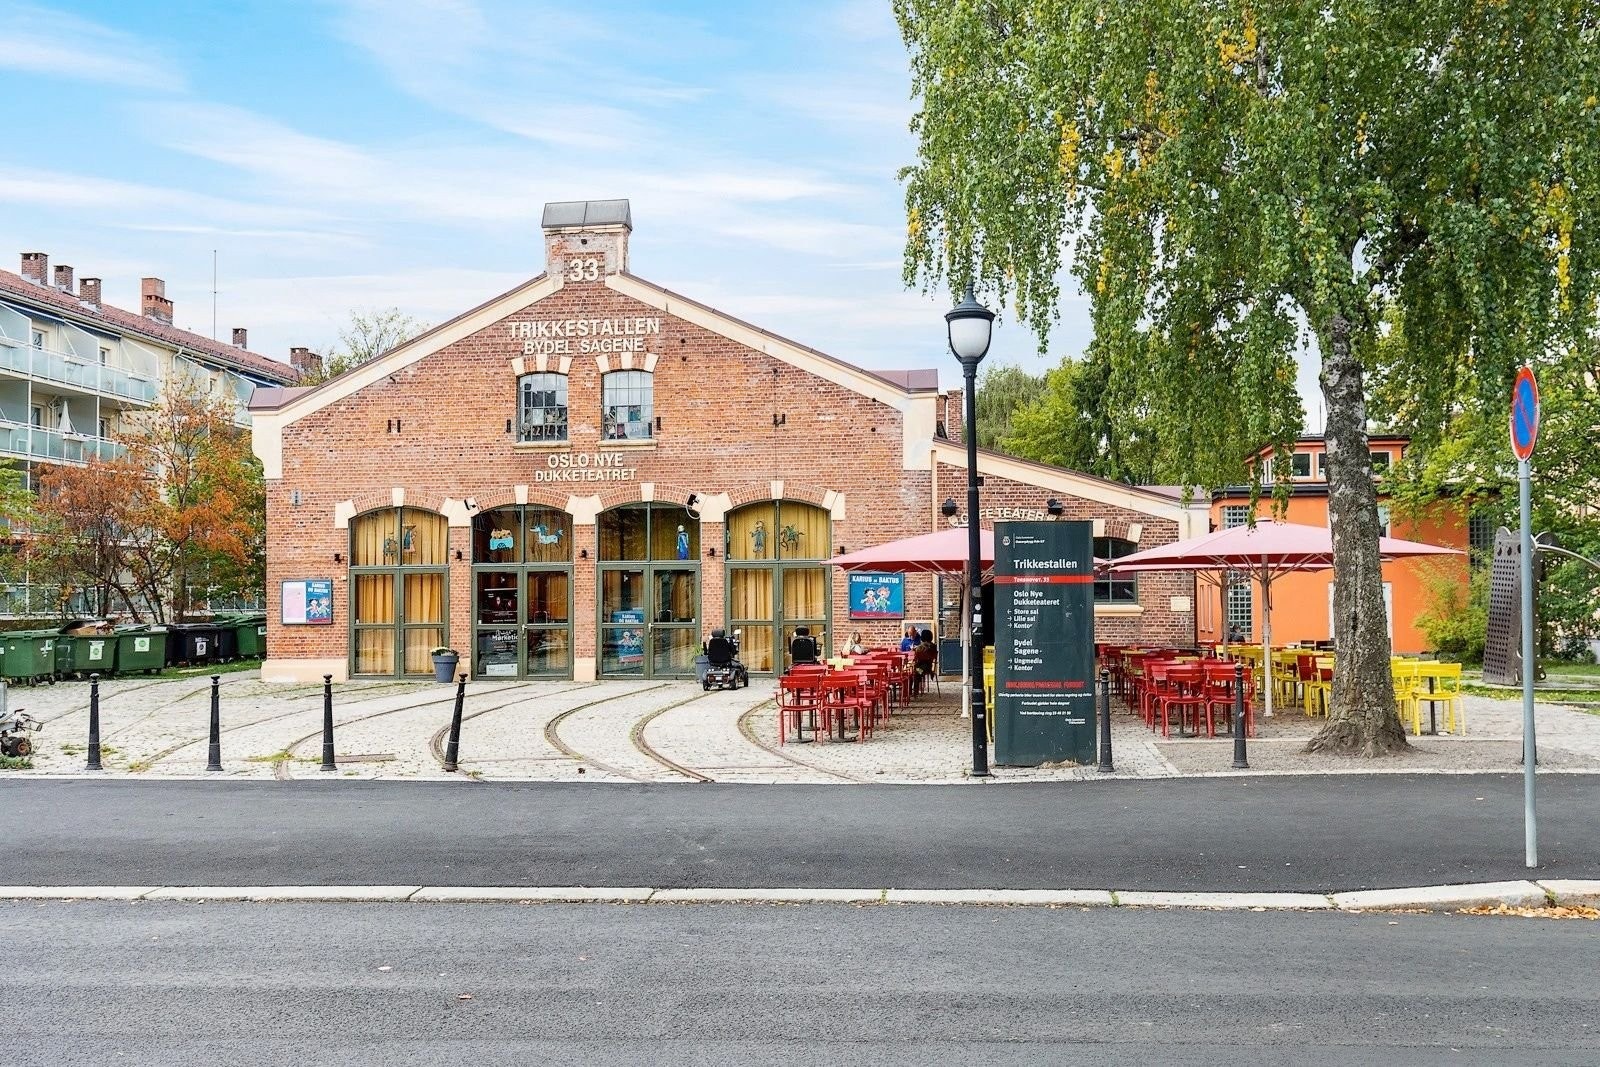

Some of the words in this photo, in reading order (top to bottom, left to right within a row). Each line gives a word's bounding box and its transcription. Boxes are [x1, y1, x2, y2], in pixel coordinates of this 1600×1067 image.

[569, 258, 600, 282] 33
[508, 317, 660, 338] TRIKKESTALLEN
[524, 339, 573, 355] BYDEL
[580, 337, 644, 353] SAGENE
[548, 454, 589, 468] OSLO
[593, 453, 624, 467] NYE
[535, 468, 637, 482] DUKKETEATRET
[994, 507, 1045, 521] TEATER
[1013, 559, 1078, 569] Trikkestallen
[1030, 590, 1043, 599] Nye
[1013, 598, 1060, 606] Dukketeateret
[1013, 639, 1033, 647] Bydel
[1014, 647, 1039, 655] Sagene
[1013, 657, 1043, 665] Ungmedia
